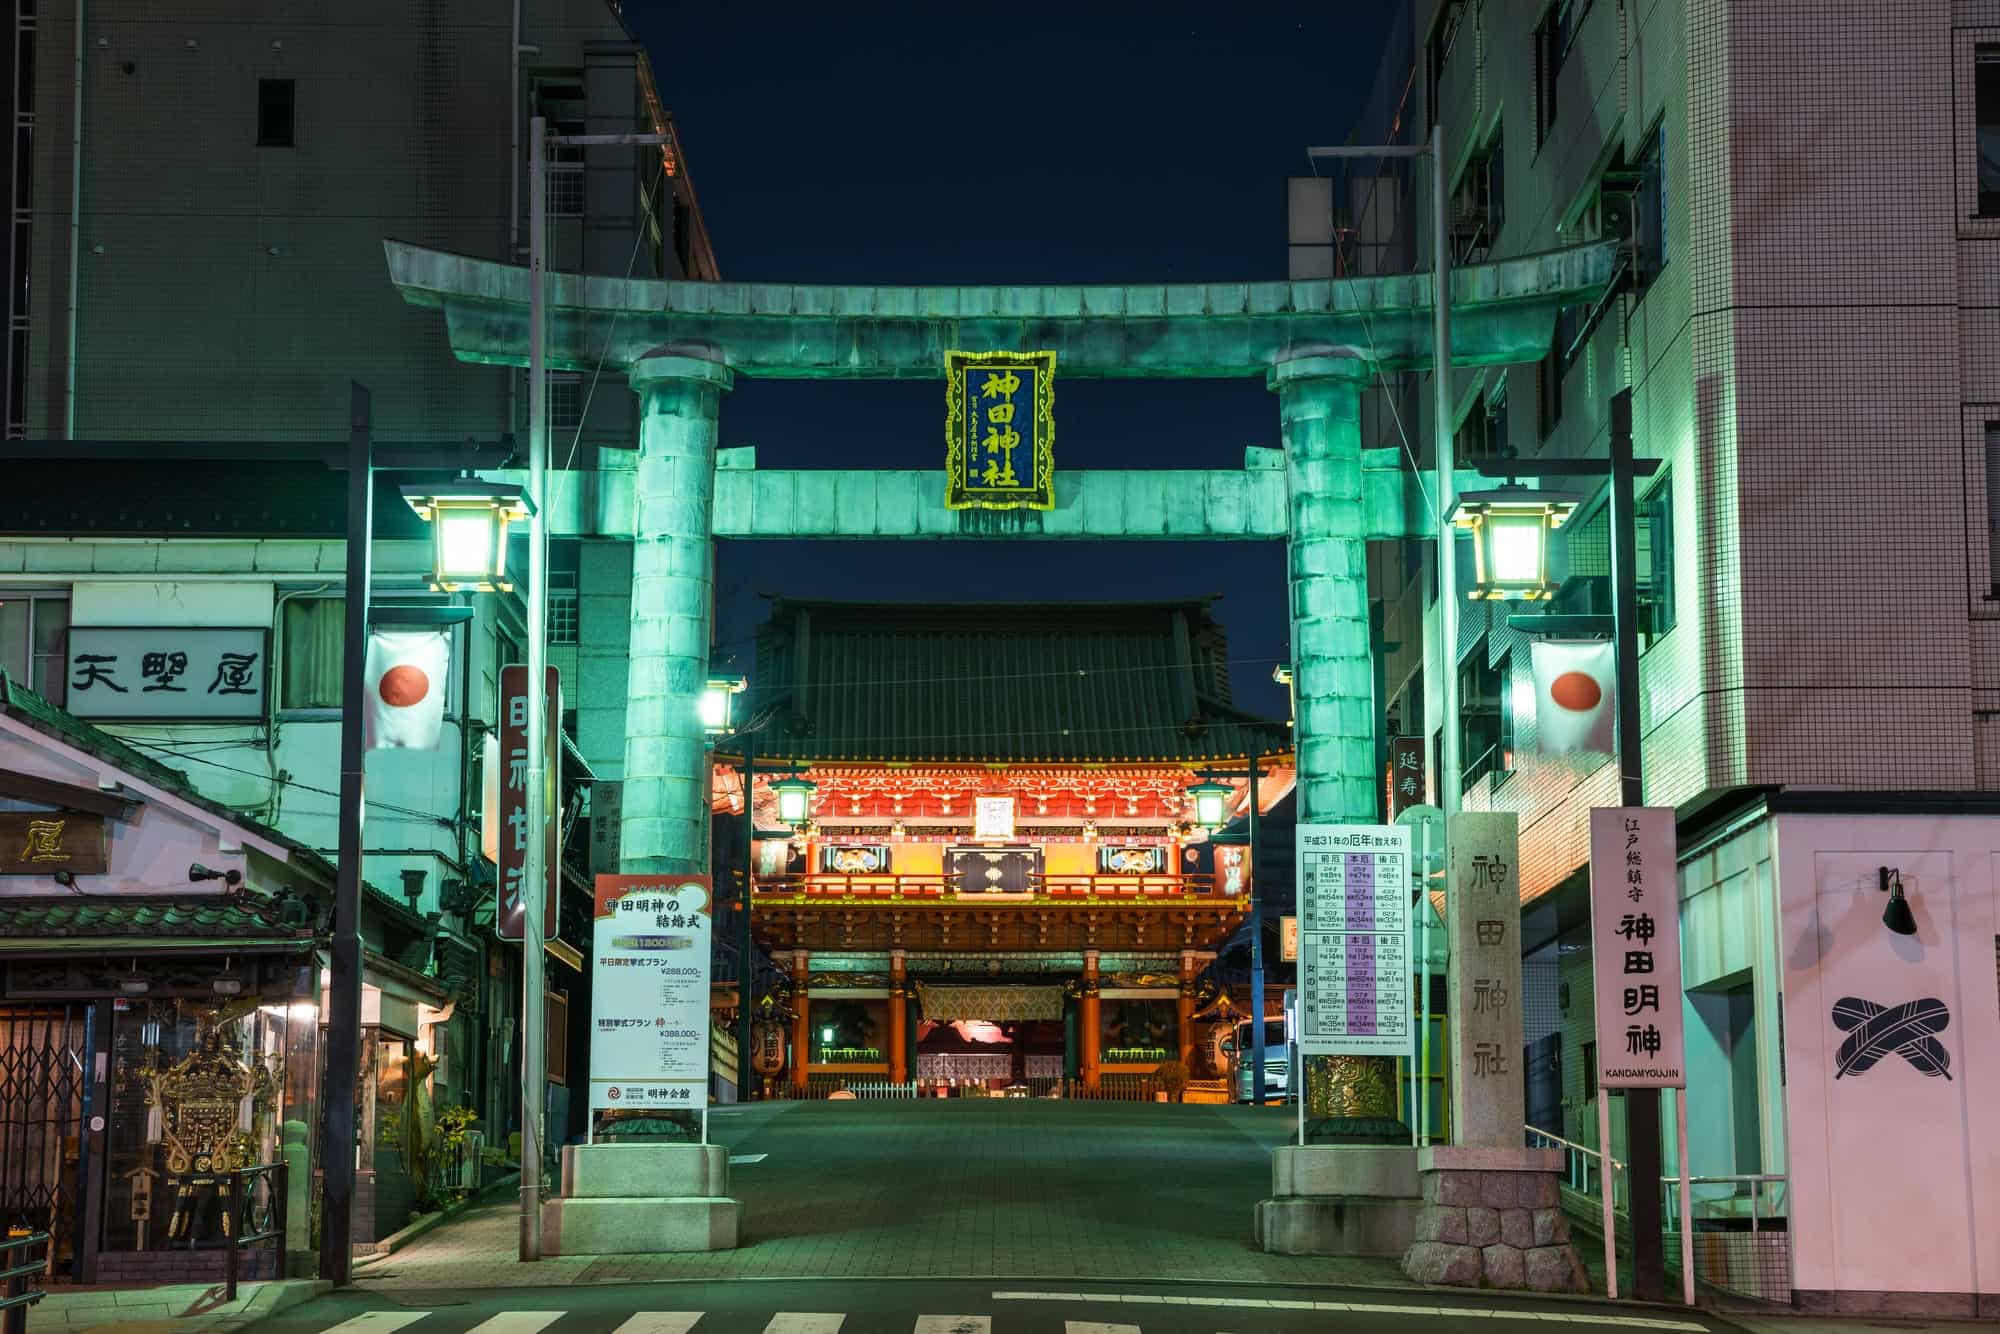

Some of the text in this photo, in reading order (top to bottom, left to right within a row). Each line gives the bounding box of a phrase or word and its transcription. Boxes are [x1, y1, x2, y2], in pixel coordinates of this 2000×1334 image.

[981, 370, 1021, 487] 神田神社
[1400, 752, 1418, 796] 延寿
[20, 820, 71, 862] 屋
[1625, 818, 1644, 902] 江戸総鎮守
[606, 898, 680, 912] 神田明神の
[656, 914, 701, 928] 結婚式
[1471, 855, 1508, 1079] 神田神社
[1615, 912, 1662, 1060] 神田明神
[648, 1088, 690, 1099] 明神会館
[1606, 1069, 1679, 1078] KANDAMYOUJIN
